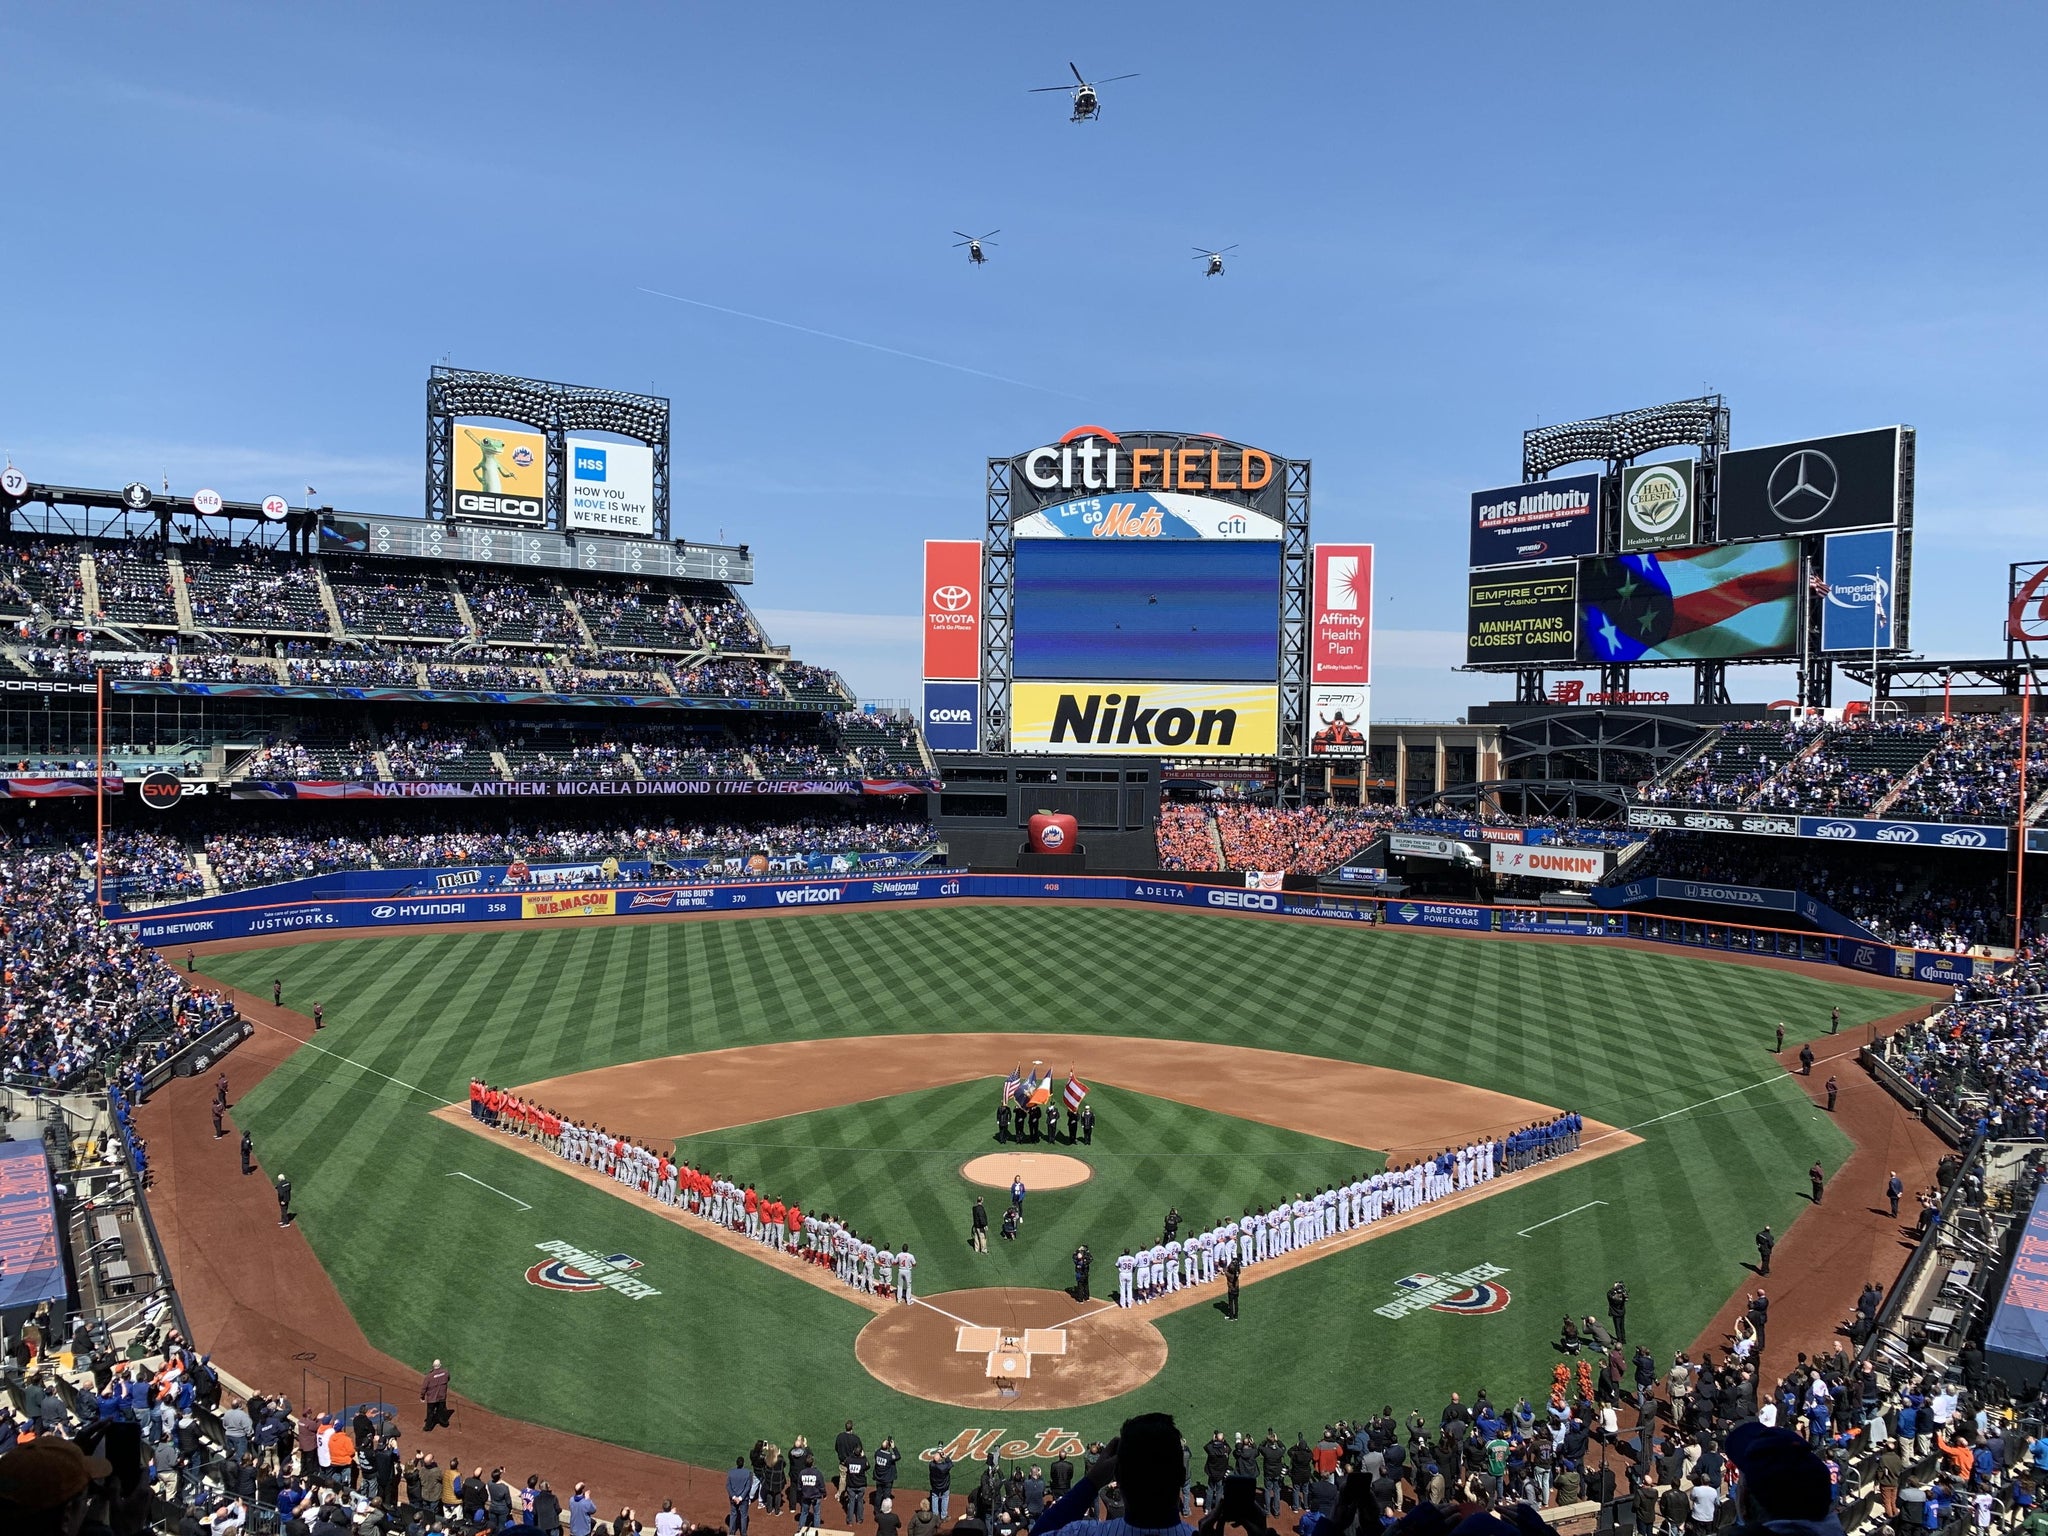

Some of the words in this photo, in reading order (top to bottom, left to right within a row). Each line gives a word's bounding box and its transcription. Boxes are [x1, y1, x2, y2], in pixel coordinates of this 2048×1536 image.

[578, 458, 603, 471] HSS
[1024, 437, 1116, 489] citi
[1132, 448, 1273, 490] FIELD
[6, 475, 21, 489] 37
[1643, 483, 1671, 494] HAIN
[574, 486, 600, 498] HOW
[603, 489, 625, 499] YOU
[1630, 489, 1684, 505] CELESTIAL
[198, 496, 219, 506] SHEA
[459, 494, 539, 517] GEICO
[574, 499, 606, 510] MOVE
[608, 501, 618, 511] IS
[622, 503, 646, 514] WHY
[1479, 501, 1517, 521] Parts
[1519, 489, 1590, 515] Authority
[267, 502, 283, 514] 42
[1060, 499, 1100, 517] LET'S
[574, 511, 607, 523] WE'RE
[610, 515, 641, 526] HERE.
[1083, 511, 1103, 524] GO
[1092, 503, 1165, 537] Mets
[1482, 519, 1501, 527] Auto
[1503, 516, 1526, 524] Parts
[1555, 508, 1586, 517] Stores
[1218, 515, 1246, 534] citi
[1512, 524, 1541, 533] Answer
[1543, 522, 1550, 530] Is
[485, 529, 523, 537] LEAGUE
[625, 541, 670, 550] NATIONAL
[1627, 536, 1653, 545] Healthier
[1476, 587, 1530, 601] EMPIRE
[1534, 583, 1566, 597] CITY
[1835, 583, 1876, 595] Imperial
[1504, 598, 1538, 607] CASINO
[928, 614, 975, 624] TOYOTA
[1319, 613, 1365, 628] Affinity
[1479, 617, 1563, 633] MANHATTAN'S
[1321, 628, 1361, 641] Health
[1469, 632, 1523, 647] CLOSEST
[1525, 630, 1573, 645] CASINO
[1328, 642, 1353, 654] Plan
[1317, 694, 1355, 703] RPM
[1586, 693, 1609, 702] new
[1611, 690, 1669, 702] balance
[929, 709, 972, 721] GOYA
[1050, 693, 1238, 746] Nikon
[1313, 744, 1364, 753] RPMRACEWAY.COM
[373, 782, 469, 796] NATIONAL
[471, 781, 550, 796] ANTHEM:
[557, 781, 632, 795] MICAELA
[636, 781, 710, 794] DIAMOND
[716, 781, 752, 794] (THE
[757, 781, 799, 793] CHER
[802, 781, 850, 793] SHOW)
[1463, 828, 1478, 839] citi
[1482, 829, 1520, 842] PAVILION
[1815, 826, 1851, 838] SNY
[1876, 829, 1912, 842] SNY
[1940, 833, 1978, 847] SNY
[1529, 854, 1597, 874] DUNKIN'
[676, 890, 691, 898] THIS
[693, 889, 714, 897] BUD'S
[883, 882, 919, 892] National
[940, 885, 959, 895] citi
[1044, 883, 1059, 891] 408
[1147, 886, 1184, 898] DELTA
[635, 895, 672, 904] Budweiser
[732, 895, 746, 903] 370
[776, 885, 840, 904] verizon
[1208, 890, 1278, 910] GEICO
[1699, 888, 1764, 903] HONDA
[487, 904, 506, 913] 358
[676, 898, 689, 906] FOR
[690, 898, 707, 906] YOU.
[400, 903, 465, 916] HYUNDAI
[1292, 906, 1320, 916] KONICA
[1321, 909, 1353, 919] MINOLTA
[1424, 905, 1447, 915] EAST
[1449, 907, 1479, 917] COAST
[249, 914, 339, 931] JUSTWORKS.
[1424, 914, 1453, 924] POWER
[1455, 915, 1460, 924] &
[1463, 917, 1479, 926] GAS
[143, 926, 164, 936] MLB
[166, 921, 214, 935] NETWORK
[1586, 926, 1603, 935] 370
[1920, 966, 1964, 980] Corona
[534, 1240, 615, 1276] OPENING
[597, 1271, 662, 1300] WEEK
[1123, 1262, 1131, 1270] 36
[1373, 1282, 1463, 1320] OPENING
[1446, 1262, 1511, 1287] WEEK
[919, 1427, 1086, 1463] Mets
